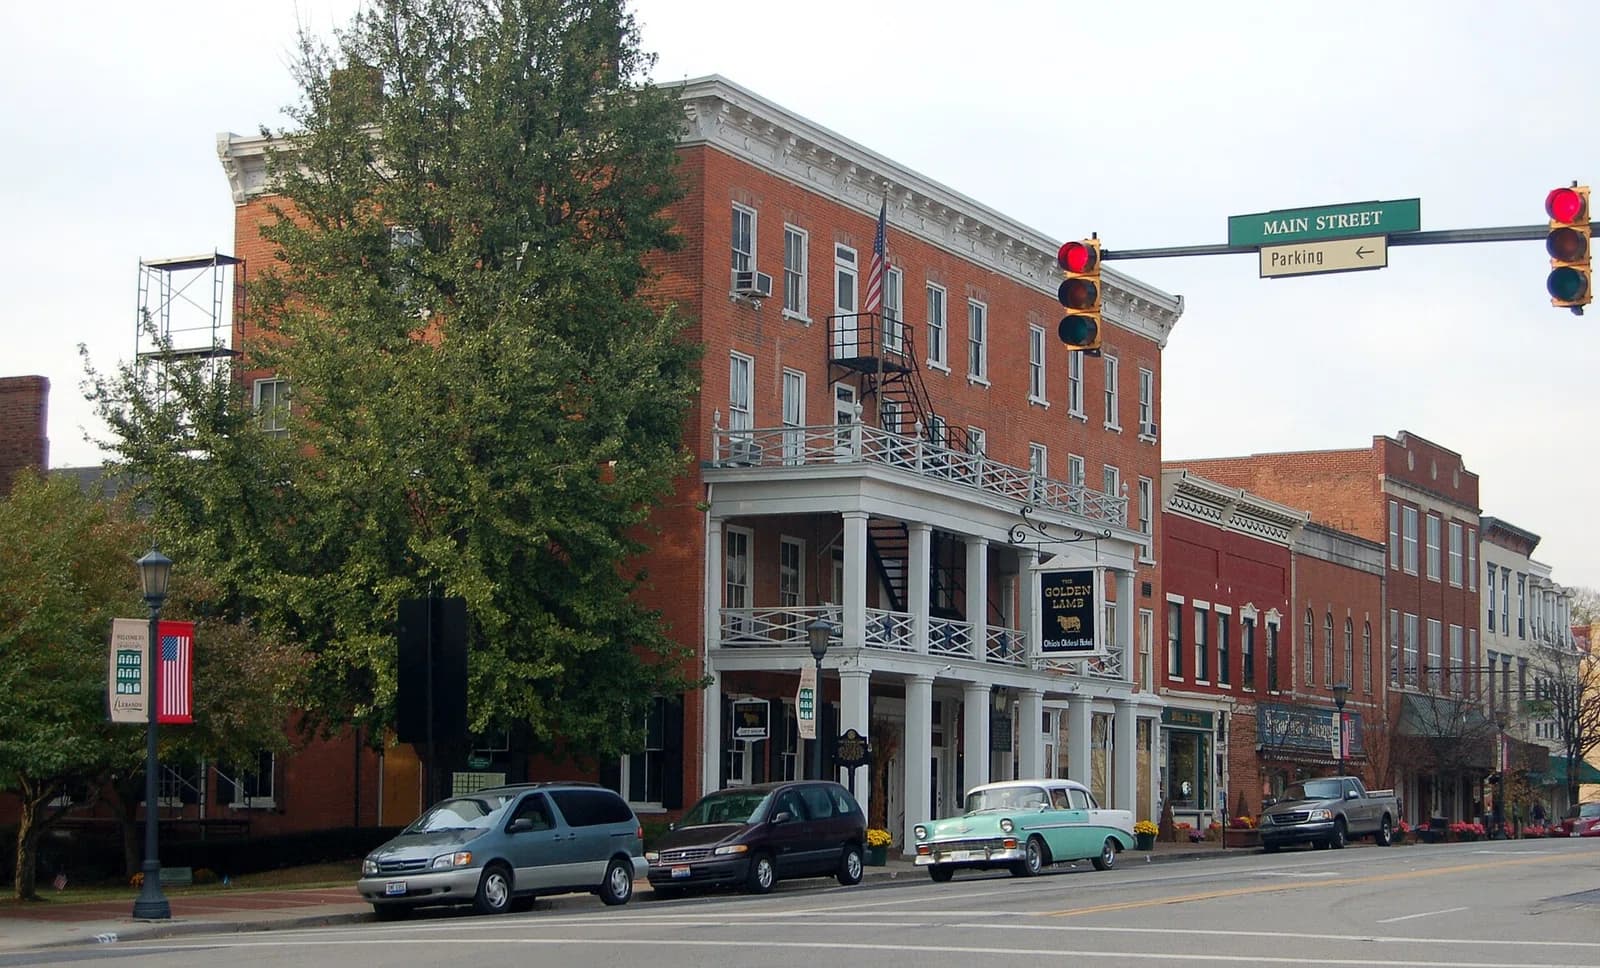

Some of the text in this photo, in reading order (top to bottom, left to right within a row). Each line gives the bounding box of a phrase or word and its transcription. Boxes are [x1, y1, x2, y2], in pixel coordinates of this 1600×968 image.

[1263, 210, 1383, 235] MAIN STREET
[1271, 250, 1324, 267] Parking
[1044, 585, 1091, 597] GOLDEN
[1052, 598, 1084, 609] LAMB
